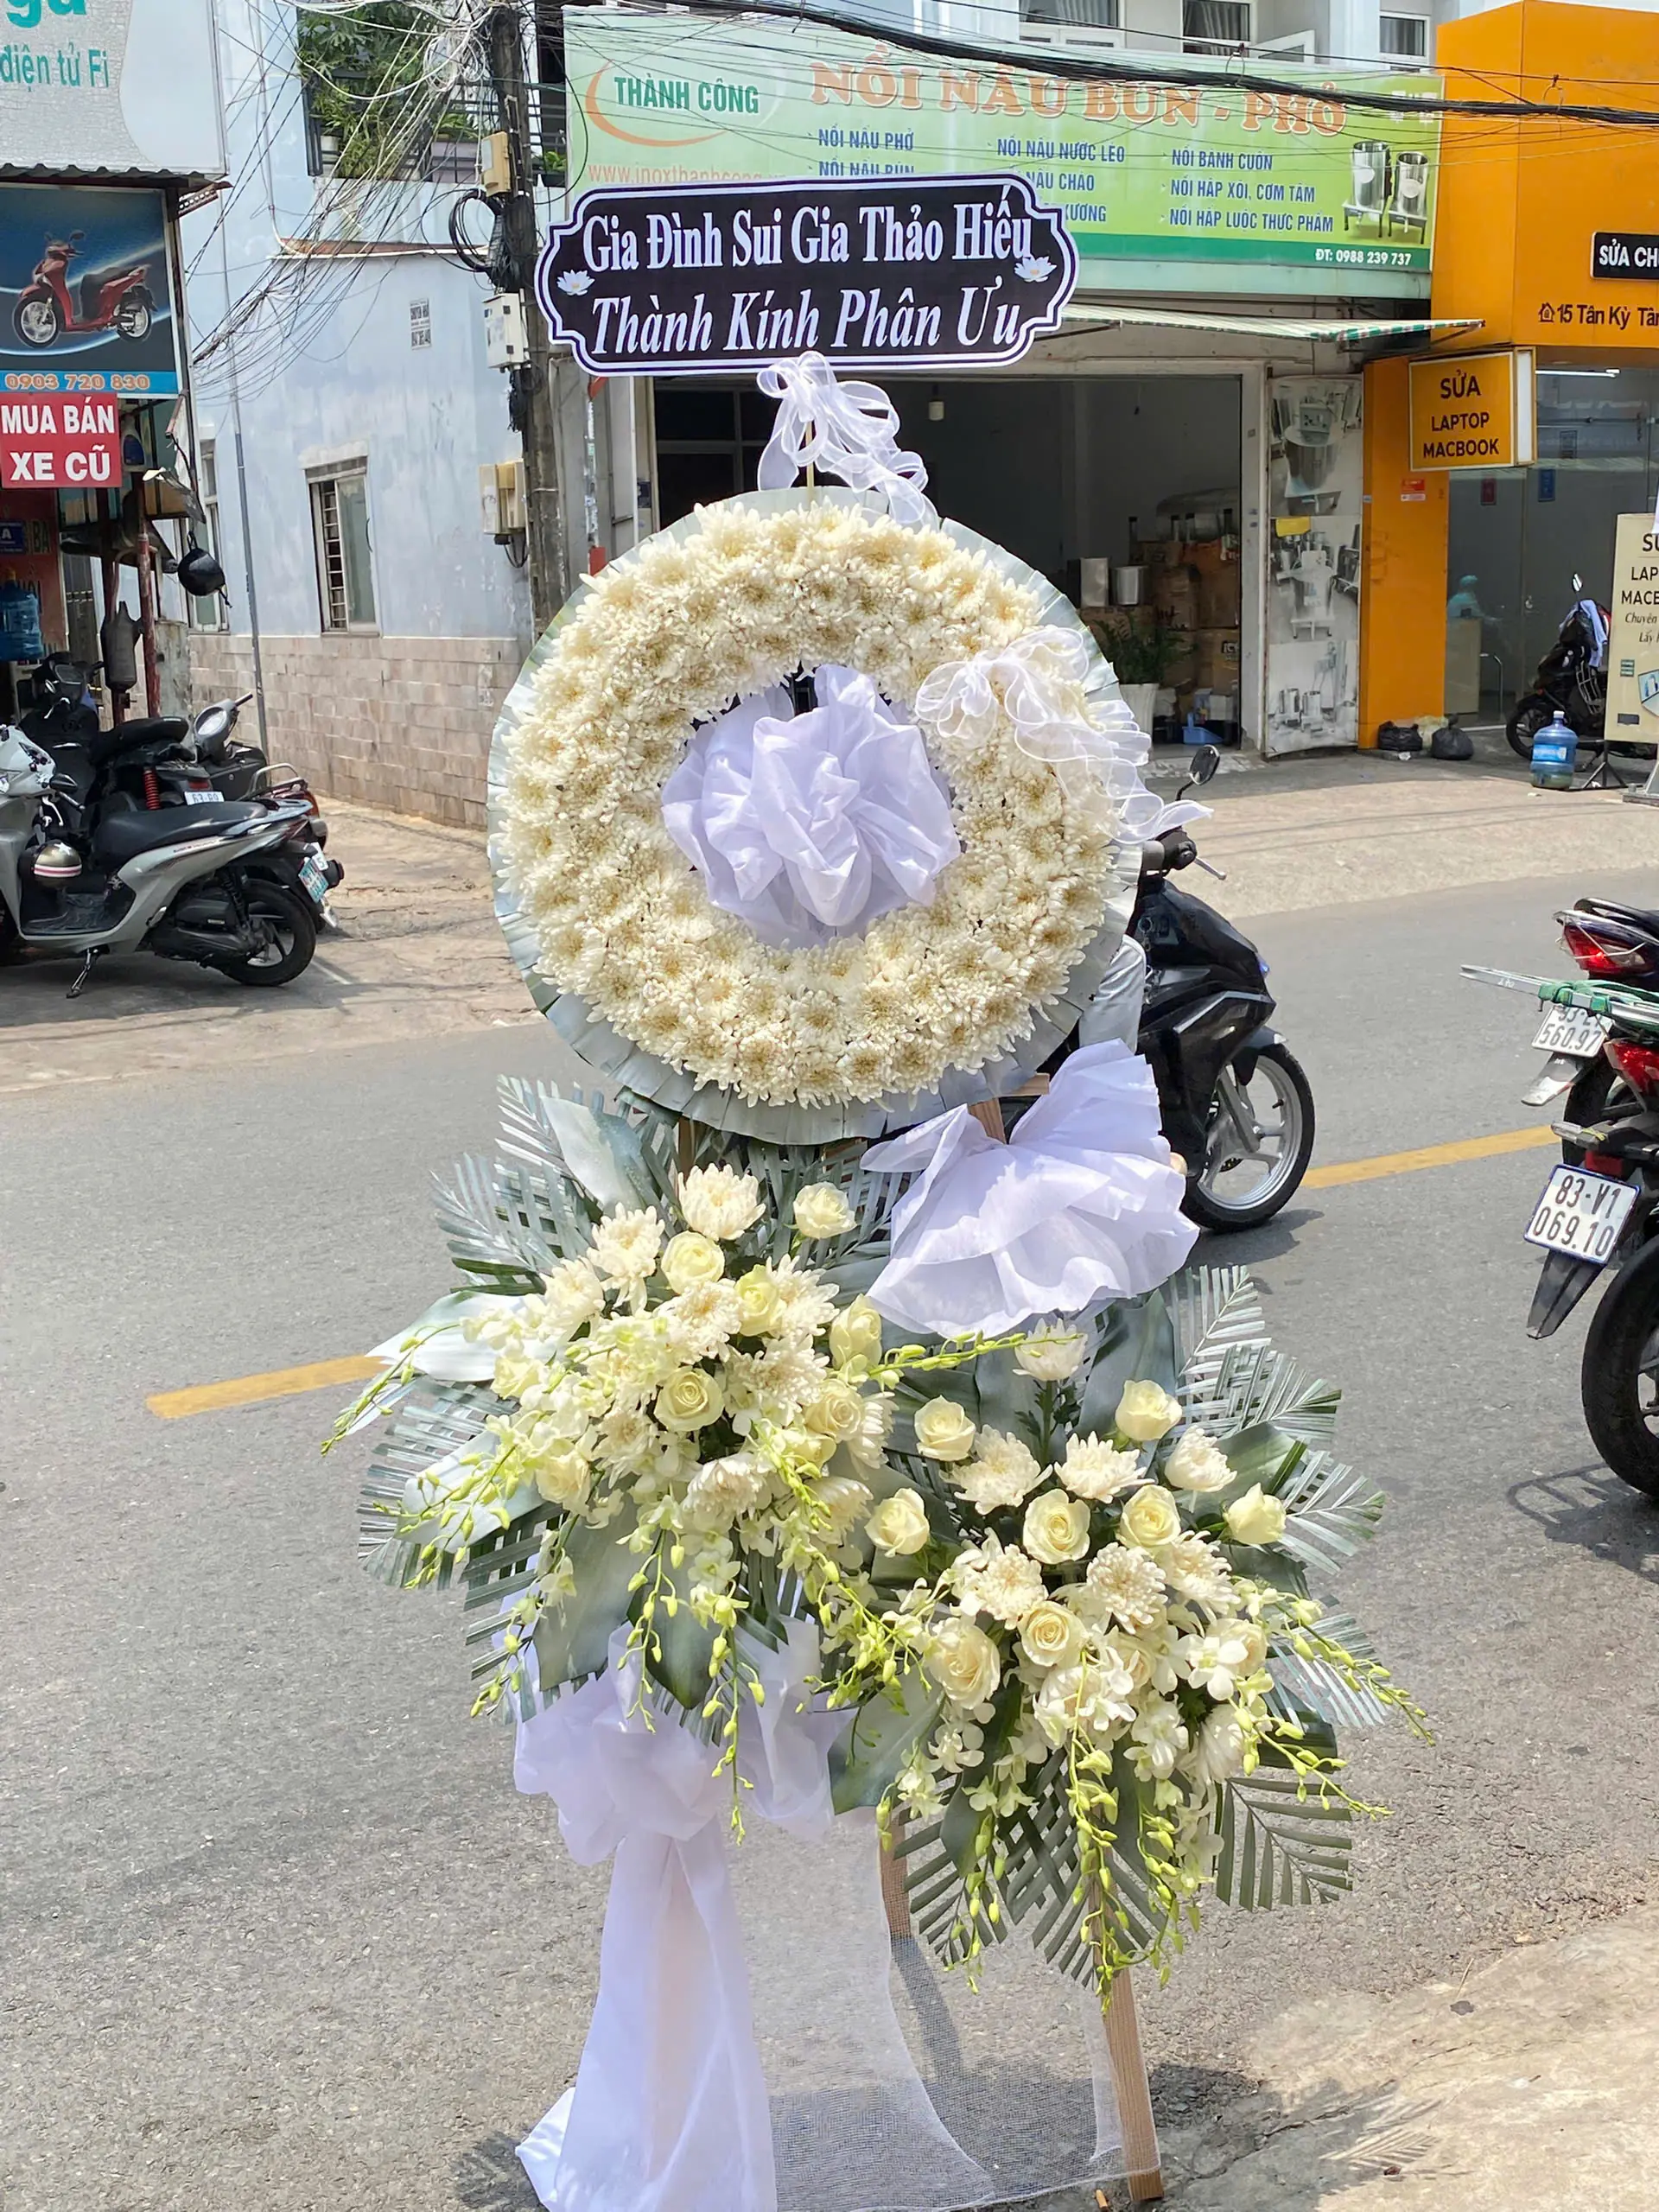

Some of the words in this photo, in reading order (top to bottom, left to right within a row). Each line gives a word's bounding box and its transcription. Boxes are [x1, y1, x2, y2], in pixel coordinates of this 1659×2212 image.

[57, 41, 80, 86] tử
[88, 49, 109, 87] Fi
[614, 73, 690, 110] THÀNH
[698, 78, 760, 114] CÔNG
[582, 214, 639, 272] Gia
[646, 212, 723, 269] Đình
[733, 208, 783, 267] Sui
[791, 206, 849, 264] Gia
[859, 204, 944, 262] Thảo
[951, 185, 1033, 259] Hiếu
[1315, 248, 1332, 261] ĐT:
[1336, 249, 1364, 263] 0988
[1367, 251, 1389, 264] 239
[1391, 252, 1412, 266] 737
[1599, 238, 1630, 267] SỬA
[1634, 246, 1659, 268] CH
[591, 293, 713, 354] Thành
[722, 289, 820, 351] Kính
[830, 287, 942, 347] Phân
[957, 276, 1020, 346] Ưu
[1557, 303, 1573, 324] 15
[1576, 304, 1605, 325] Tân
[5, 373, 60, 390] 0903
[65, 373, 105, 390] 720
[111, 374, 150, 390] 830
[1440, 368, 1482, 399] SỬA
[1, 405, 57, 434] MUA
[63, 396, 115, 434] BÁN
[1431, 411, 1490, 432] LAPTOP
[10, 452, 55, 481] XE
[65, 444, 111, 481] CŨ
[1423, 438, 1499, 459] MACBOOK
[1538, 1023, 1602, 1052] 560.97
[1555, 1174, 1621, 1219] 83-V1
[1533, 1205, 1615, 1257] 069.10
